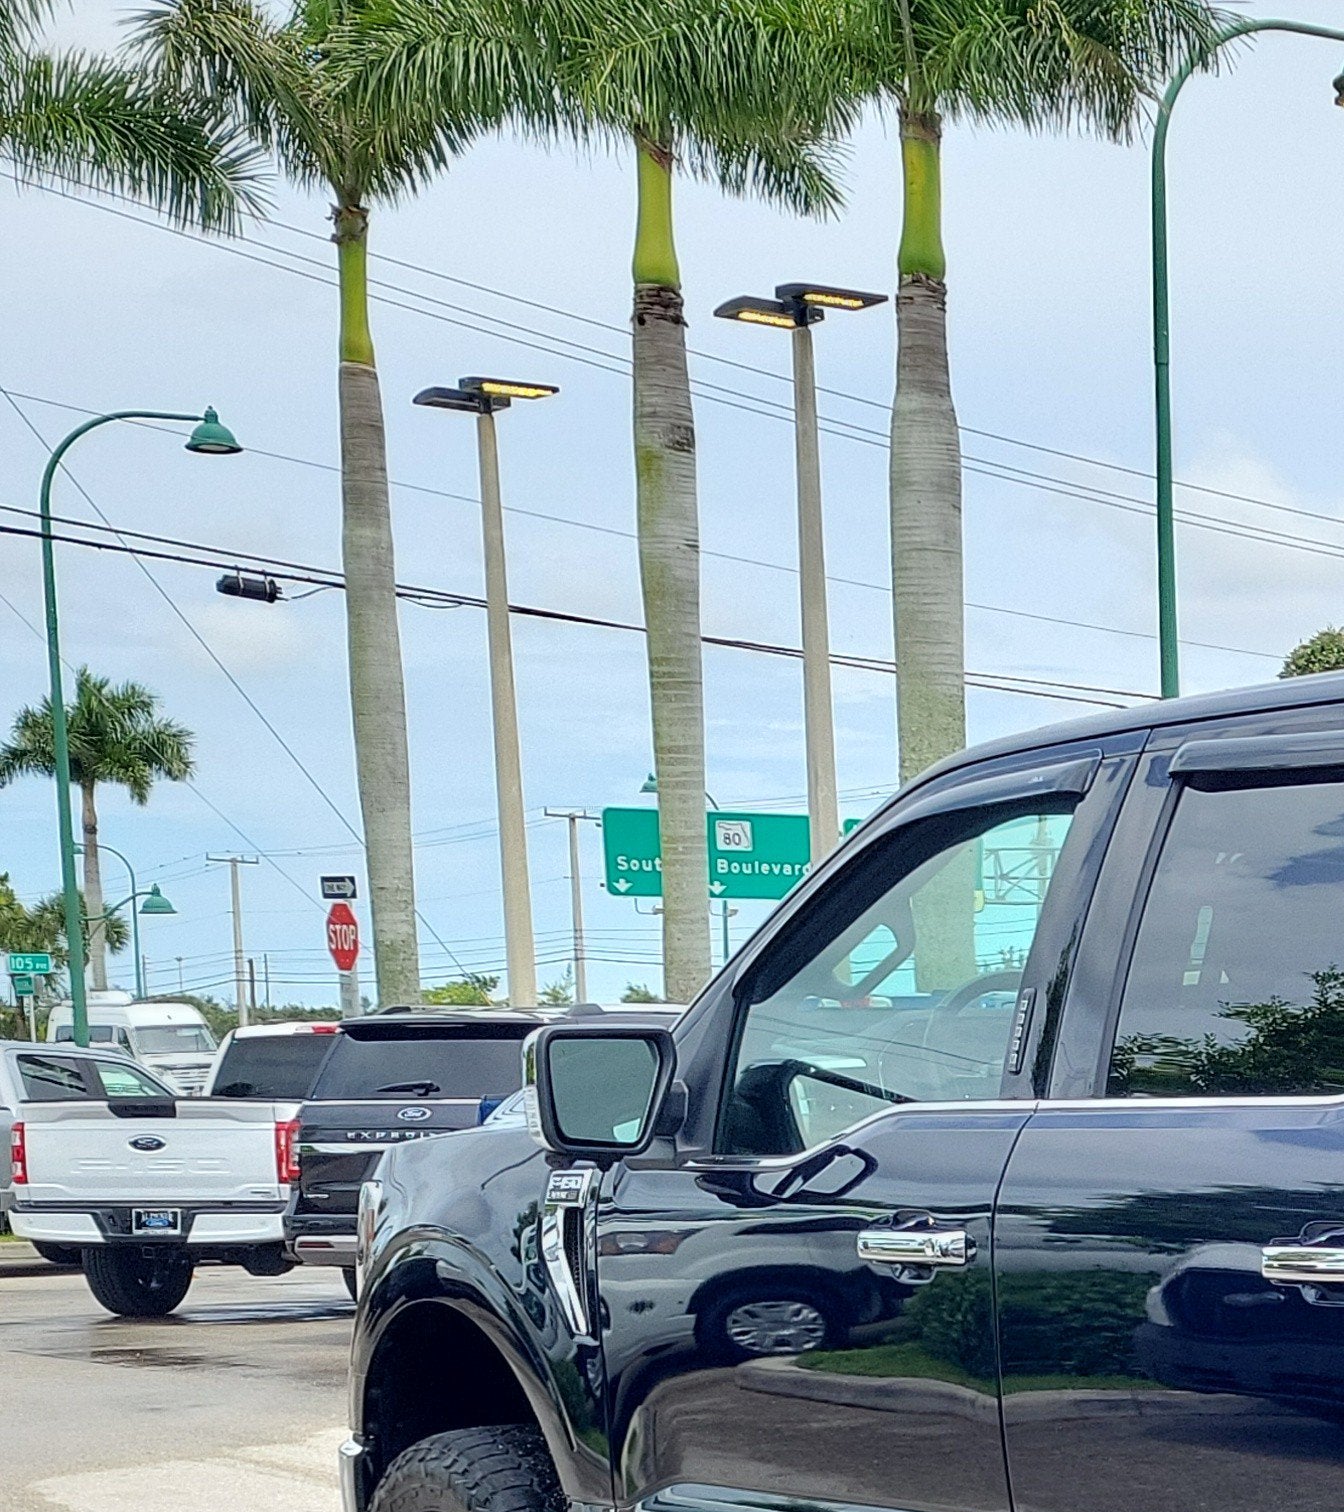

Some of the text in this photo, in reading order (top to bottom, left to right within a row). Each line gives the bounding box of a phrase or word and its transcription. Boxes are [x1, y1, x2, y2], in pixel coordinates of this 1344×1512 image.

[723, 832, 742, 847] 80
[616, 855, 662, 872] Sout
[329, 923, 356, 951] STOP
[11, 957, 34, 970] 105
